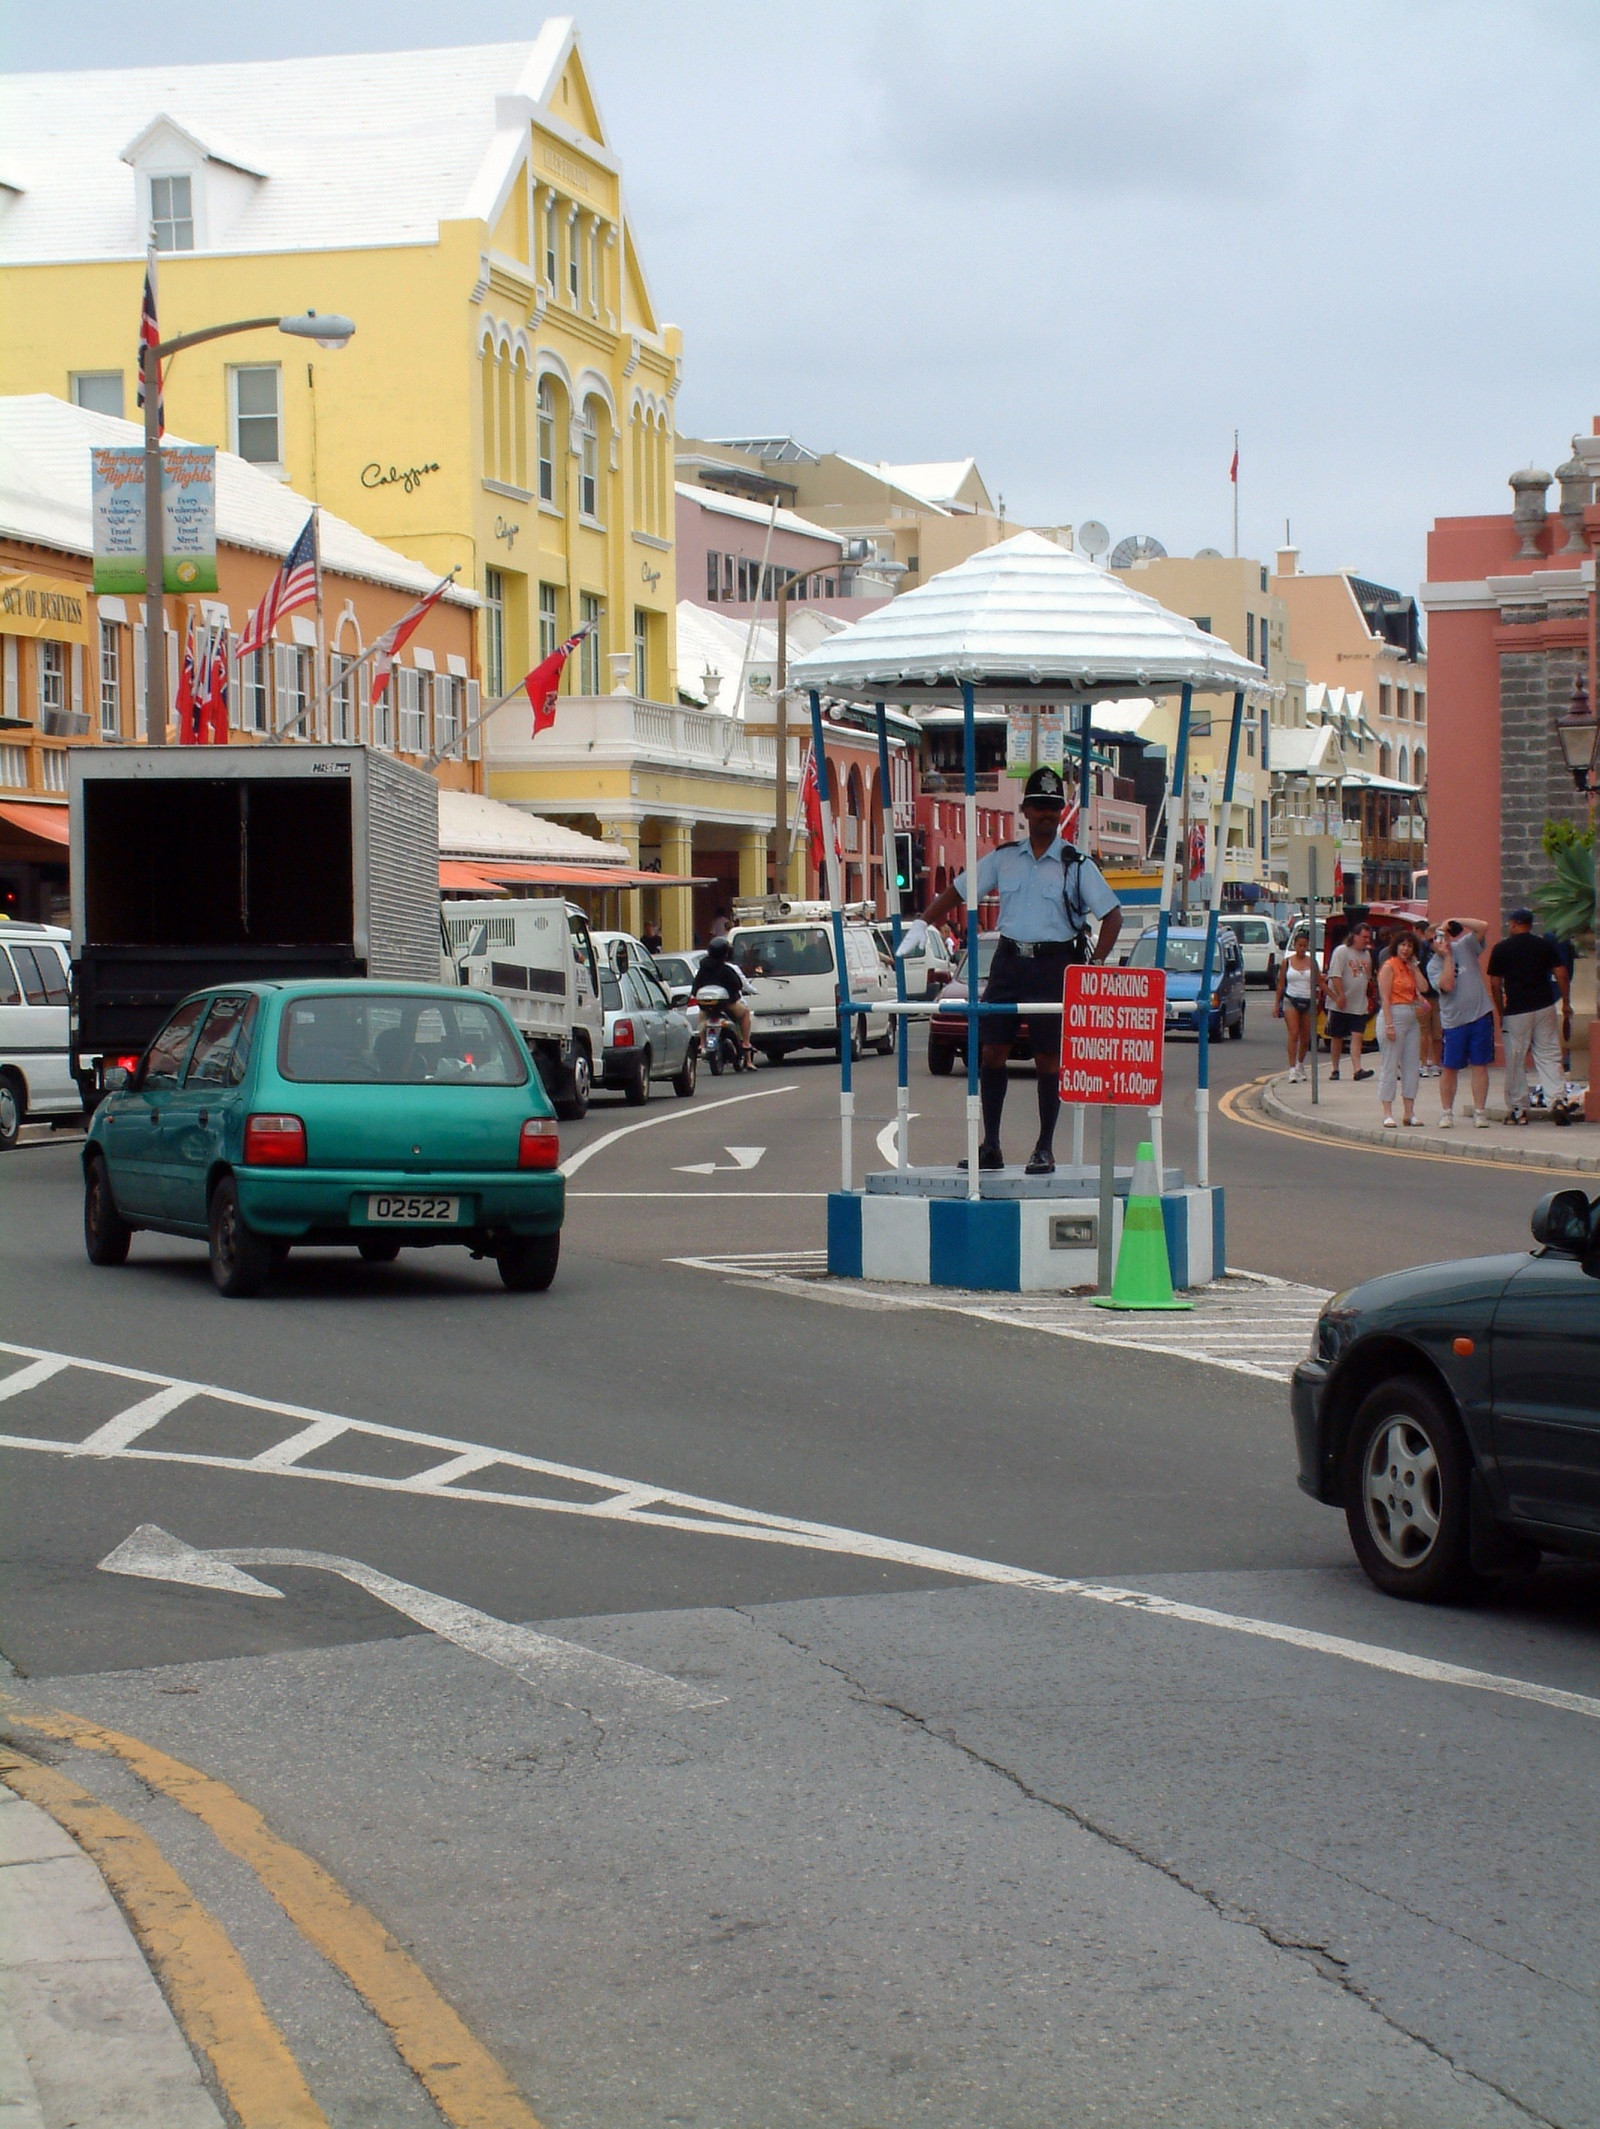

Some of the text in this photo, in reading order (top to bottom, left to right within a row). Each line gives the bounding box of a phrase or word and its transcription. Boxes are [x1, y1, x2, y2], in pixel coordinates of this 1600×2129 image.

[1081, 972, 1149, 998] NO PARKING
[1069, 1004, 1158, 1030] ON THIS STREET
[1070, 1036, 1154, 1062] TONIGHT FROM
[1063, 1069, 1103, 1097] 6.00pm
[377, 1198, 451, 1219] 02522
